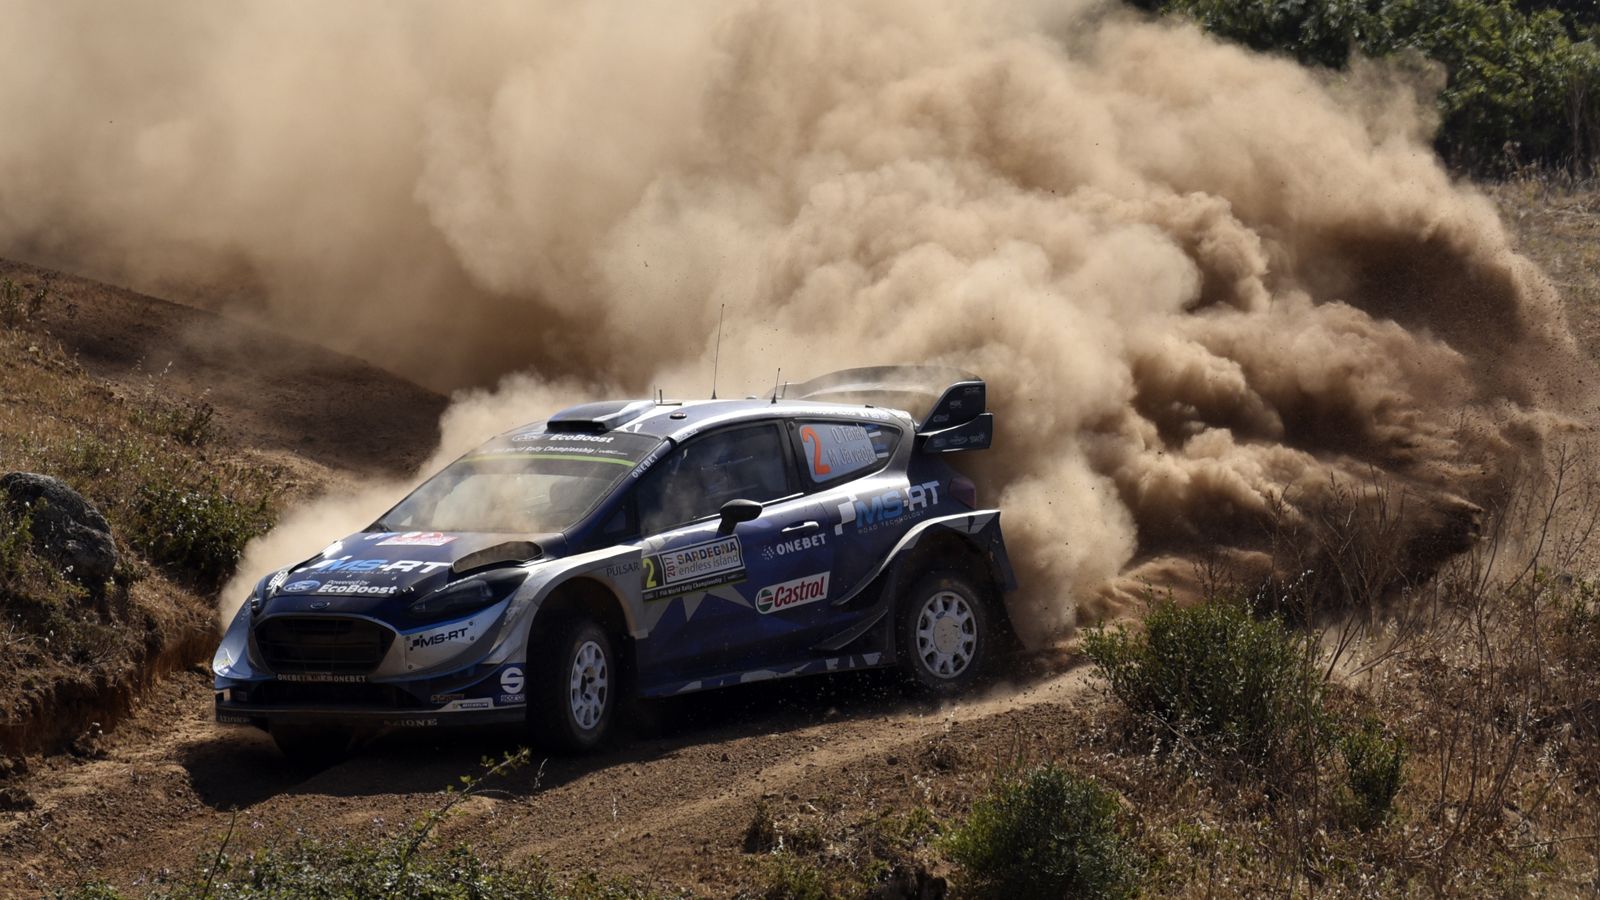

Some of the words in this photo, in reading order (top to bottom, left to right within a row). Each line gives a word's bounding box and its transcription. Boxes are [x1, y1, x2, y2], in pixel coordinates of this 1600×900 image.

[544, 446, 595, 454] Championship
[549, 434, 615, 444] EcoBoost
[801, 426, 832, 476] 2
[631, 454, 658, 479] ONEBET
[855, 480, 940, 528] MS-RT
[676, 541, 737, 565] SARDEGNA
[776, 533, 826, 555] ONEBET
[605, 562, 640, 577] PULSAR
[642, 558, 657, 588] 2
[665, 557, 676, 578] 2017
[678, 560, 711, 576] endless
[713, 553, 739, 567] island
[317, 584, 398, 594] EcoBoost
[774, 575, 825, 608] Castrol
[420, 628, 468, 648] MS-RT
